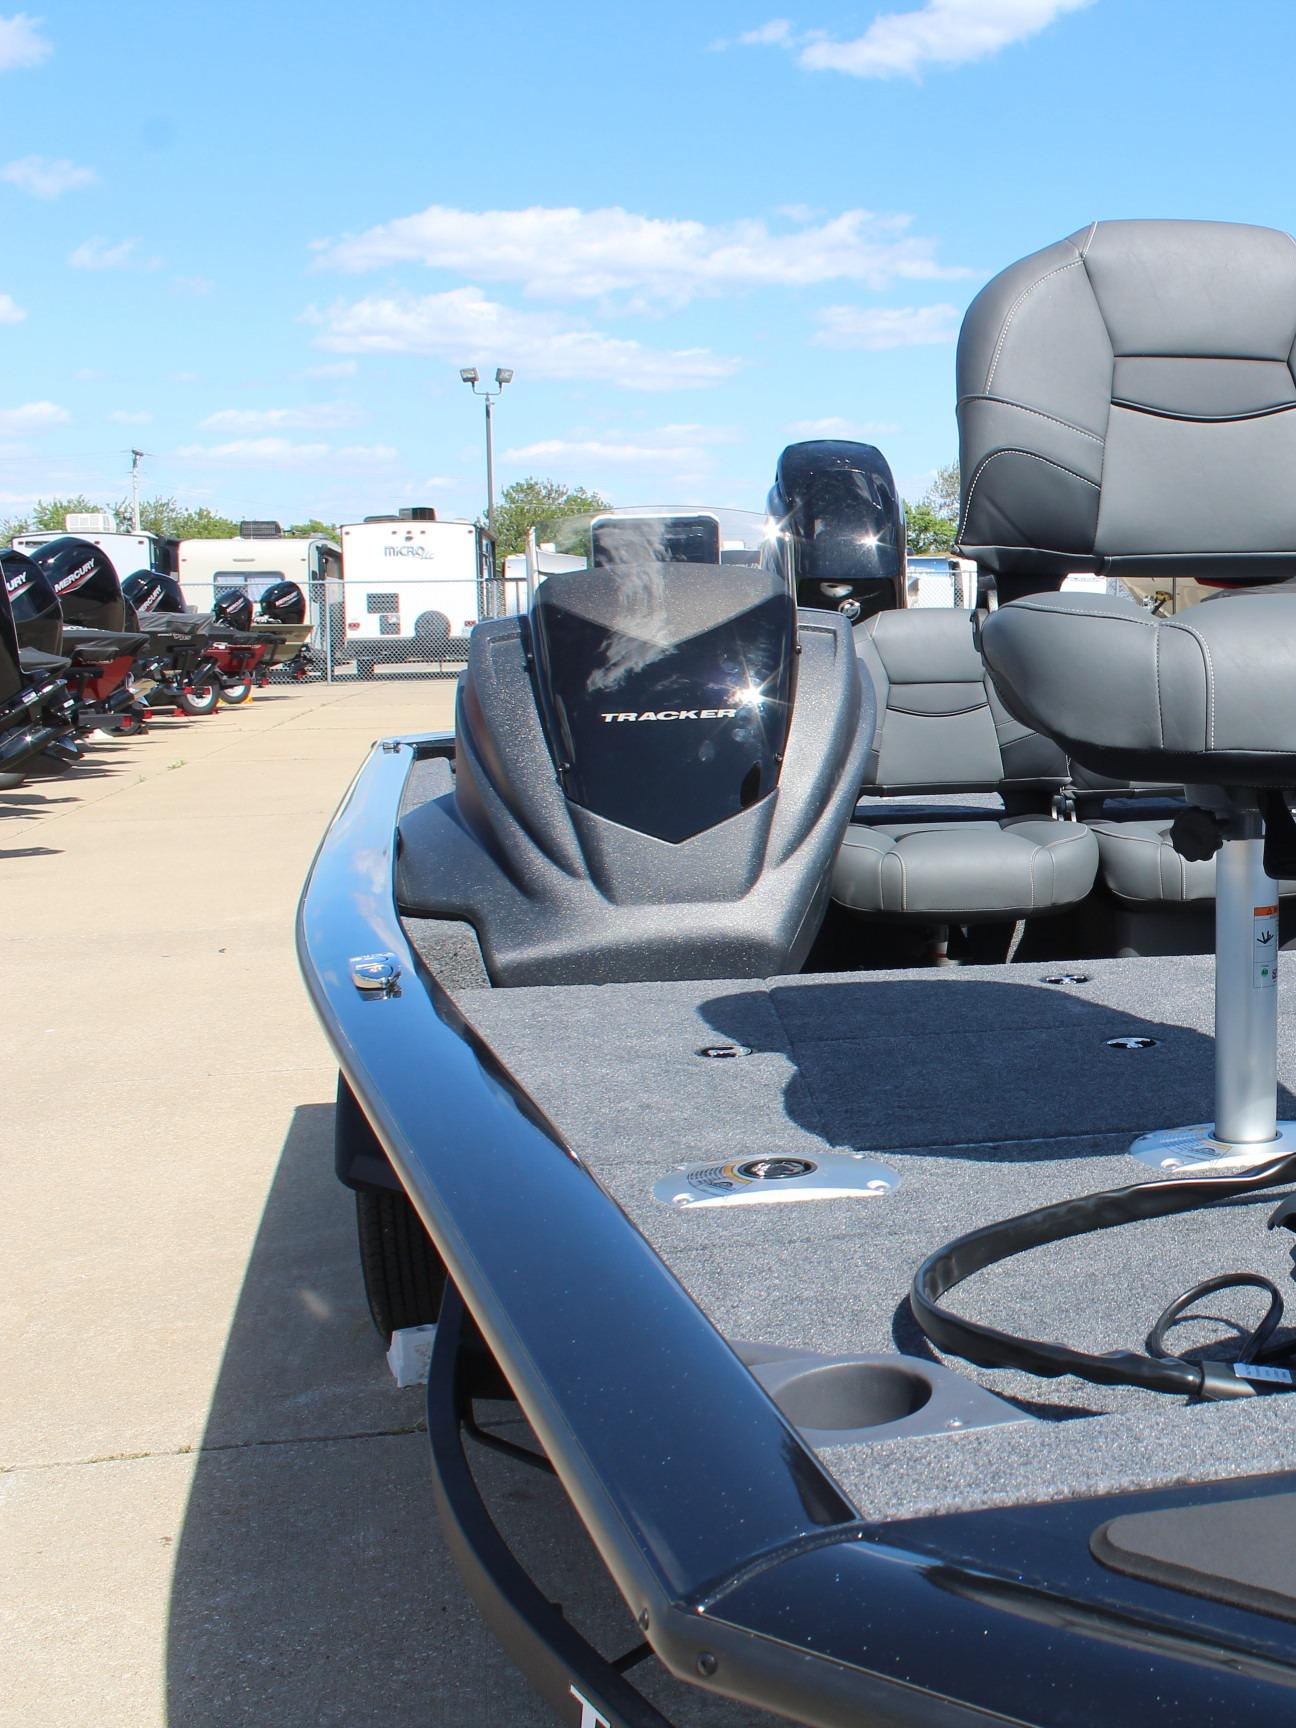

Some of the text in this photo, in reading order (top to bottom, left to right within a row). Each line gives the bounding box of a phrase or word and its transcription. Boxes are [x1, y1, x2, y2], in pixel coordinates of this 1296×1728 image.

[54, 558, 95, 593] MERCURY
[138, 584, 162, 612] ERCURY
[601, 708, 737, 723] TRACKER
